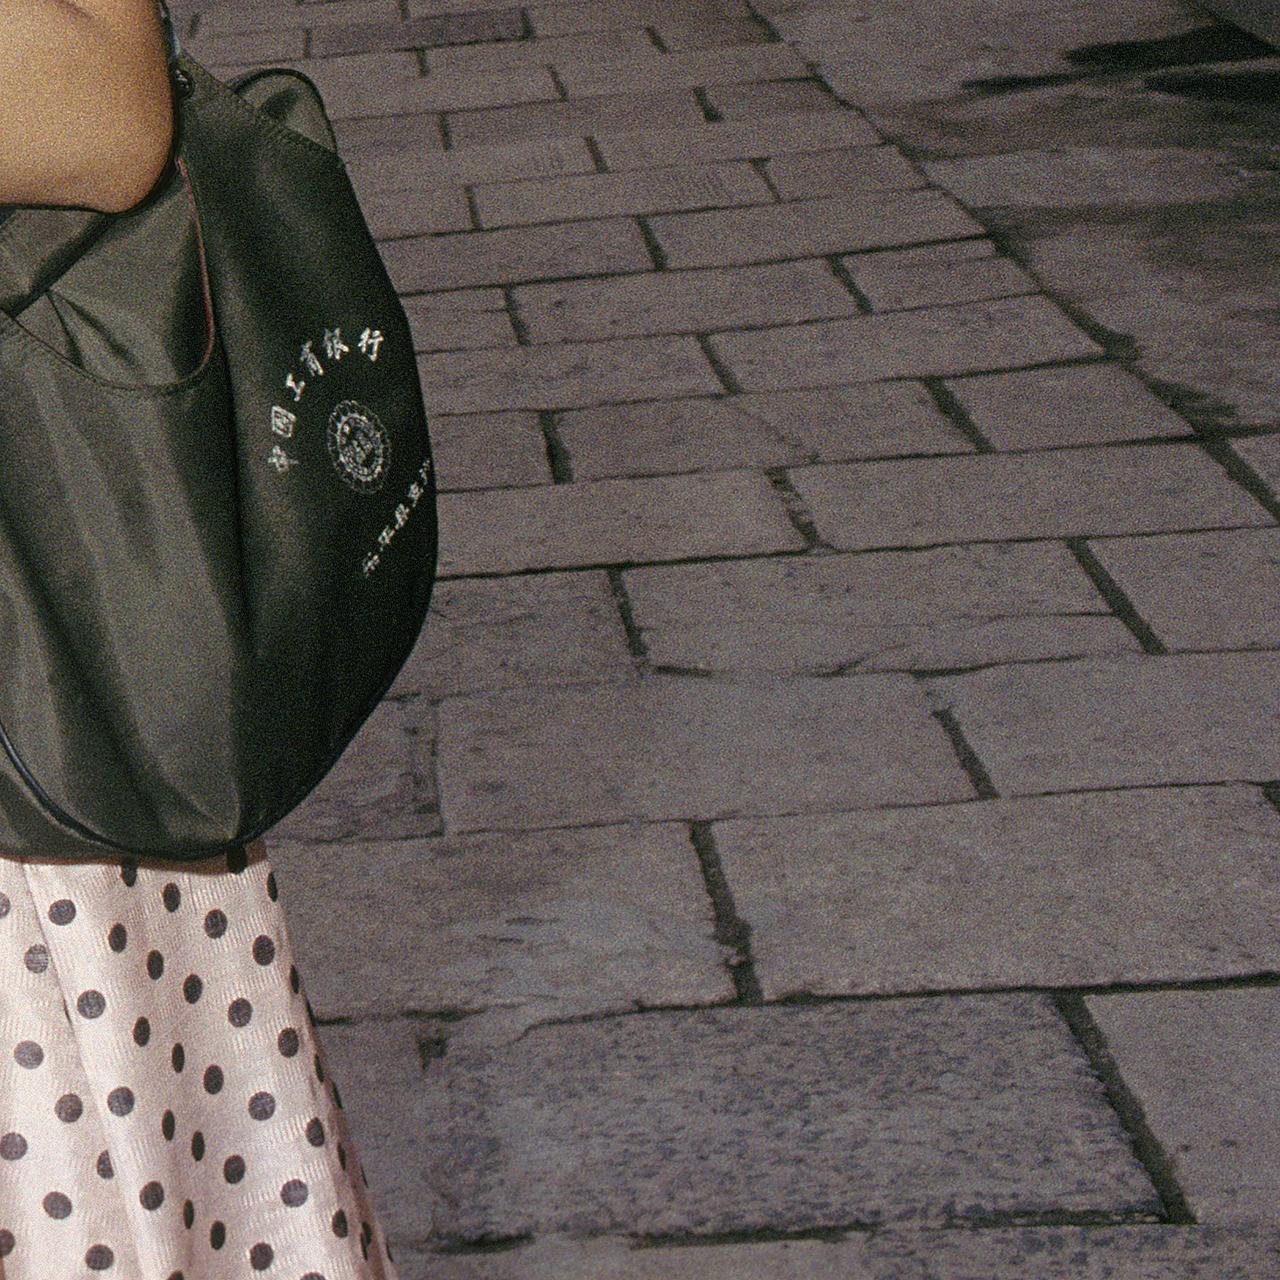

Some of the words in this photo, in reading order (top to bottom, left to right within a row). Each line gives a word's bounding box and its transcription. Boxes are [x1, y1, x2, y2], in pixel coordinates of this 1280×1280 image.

[268, 326, 384, 474] 中国工商银行
